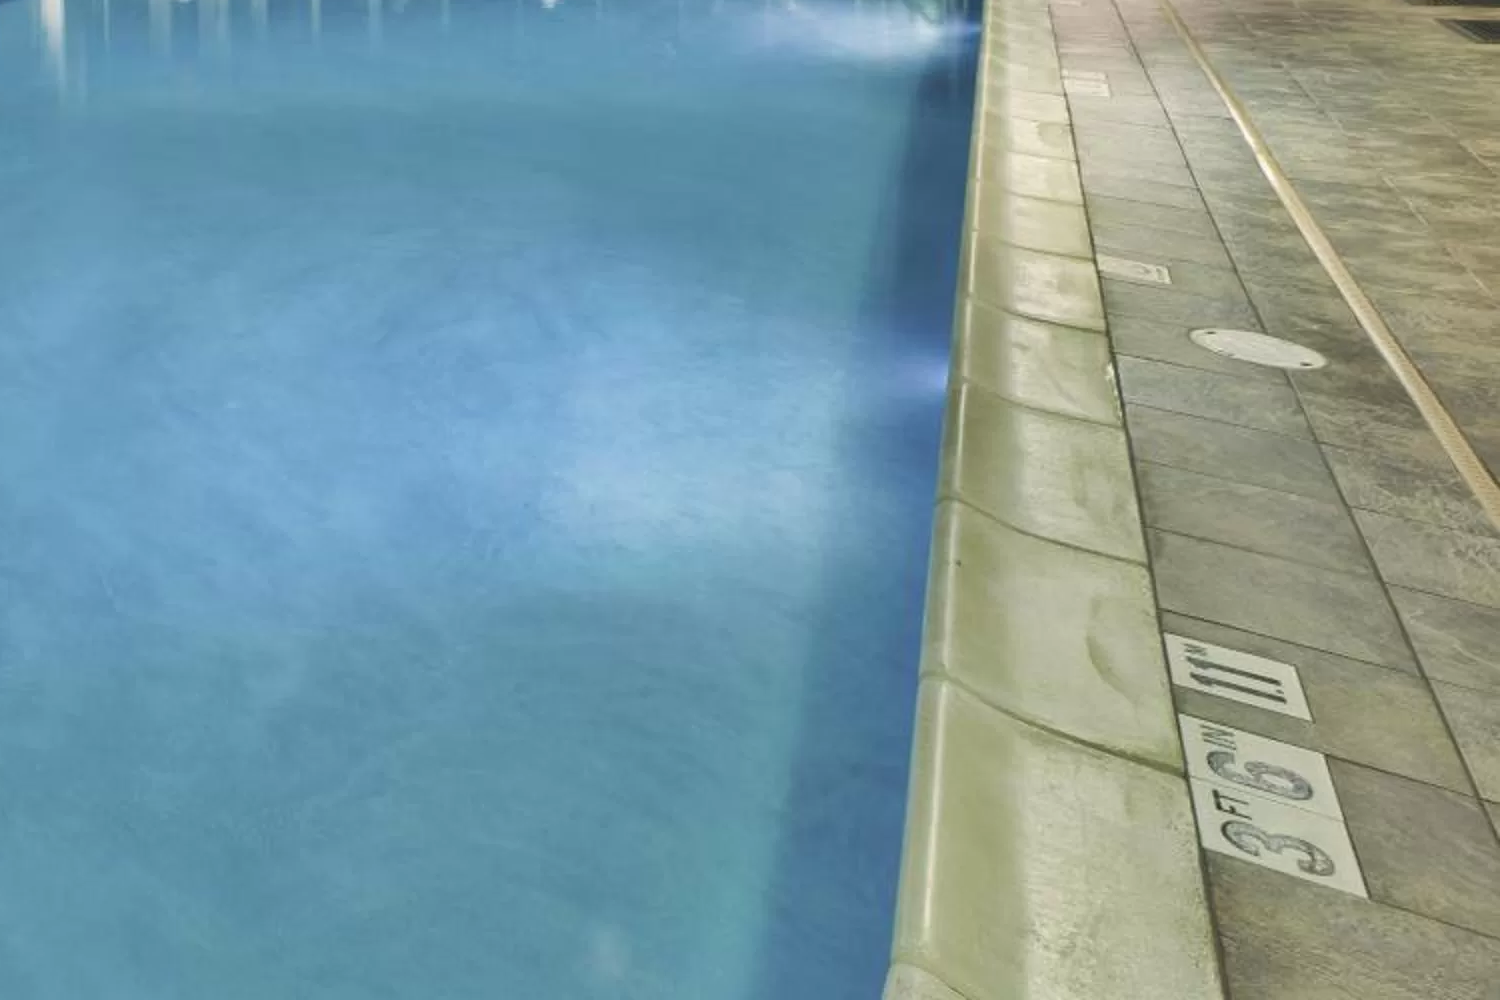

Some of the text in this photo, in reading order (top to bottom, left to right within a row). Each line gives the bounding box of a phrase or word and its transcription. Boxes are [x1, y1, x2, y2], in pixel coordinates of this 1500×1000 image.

[1200, 723, 1337, 877] 3 FT 6 IN
